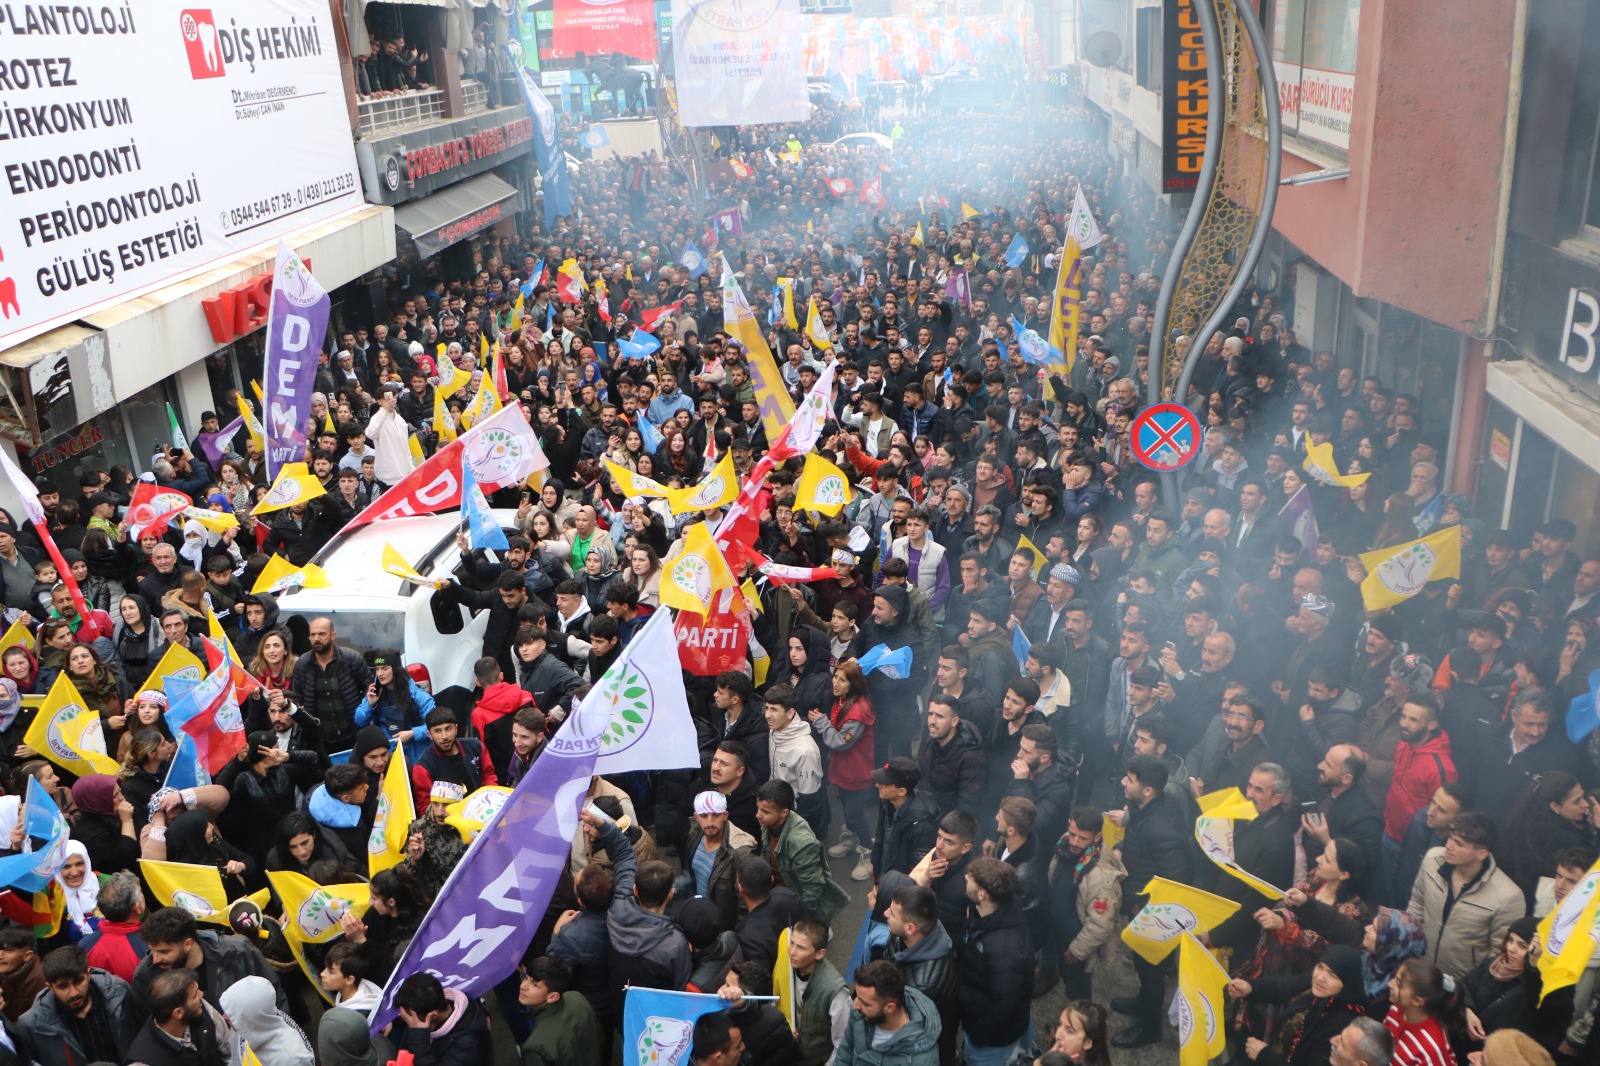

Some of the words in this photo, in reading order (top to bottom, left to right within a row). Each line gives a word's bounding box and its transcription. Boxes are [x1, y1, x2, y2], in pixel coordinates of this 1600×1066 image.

[218, 17, 256, 74] DİŞ
[256, 16, 322, 61] HEKİMİ
[1277, 81, 1300, 118] ŞAR
[1301, 76, 1330, 109] SÜRÜCÜ
[1177, 79, 1209, 173] KURSU
[5, 138, 142, 195] ENDODONTİ
[19, 172, 201, 248] PERİODONTOLOJİ
[230, 205, 253, 227] 0544
[253, 199, 270, 219] 544
[270, 195, 280, 213] 67
[281, 192, 292, 209] 39
[303, 180, 323, 206] (438)
[322, 179, 336, 196] 211
[336, 175, 346, 191] 32
[345, 172, 355, 188] 33
[36, 247, 115, 297] GÜLÜŞ
[117, 216, 204, 272] ESTETİĞİ
[271, 314, 311, 439] DEM
[32, 425, 104, 474] TUNCER
[676, 622, 739, 649] PARTİ
[51, 738, 60, 752] DEM
